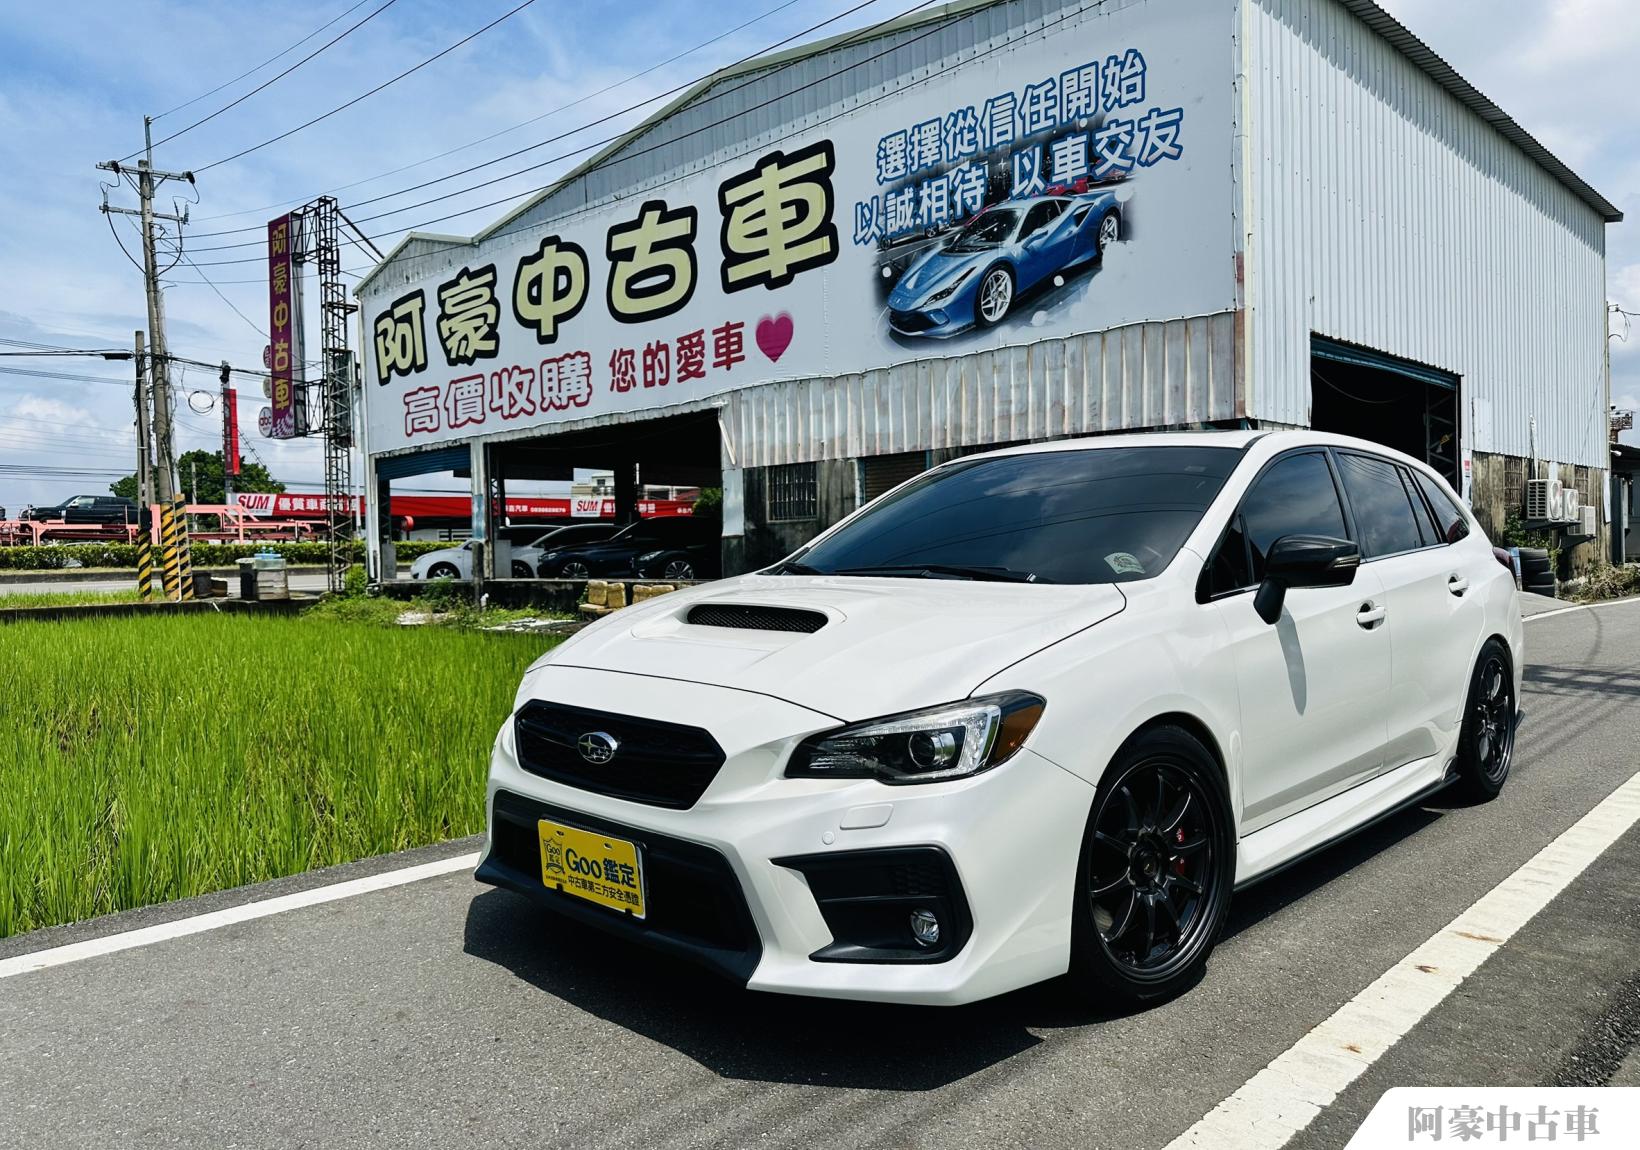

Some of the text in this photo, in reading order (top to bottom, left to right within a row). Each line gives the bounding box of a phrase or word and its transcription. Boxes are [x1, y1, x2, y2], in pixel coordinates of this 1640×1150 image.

[853, 107, 1183, 245] 以誠相待 以車交友
[876, 49, 1147, 184] 選擇從信任開始
[272, 223, 290, 410] 阿豪中古車
[374, 139, 838, 385] 阿豪中古車
[403, 320, 746, 437] 高價收購 您的愛車
[238, 495, 270, 510] SUM
[576, 500, 598, 511] SUM
[565, 848, 637, 889] Goo 鑑定
